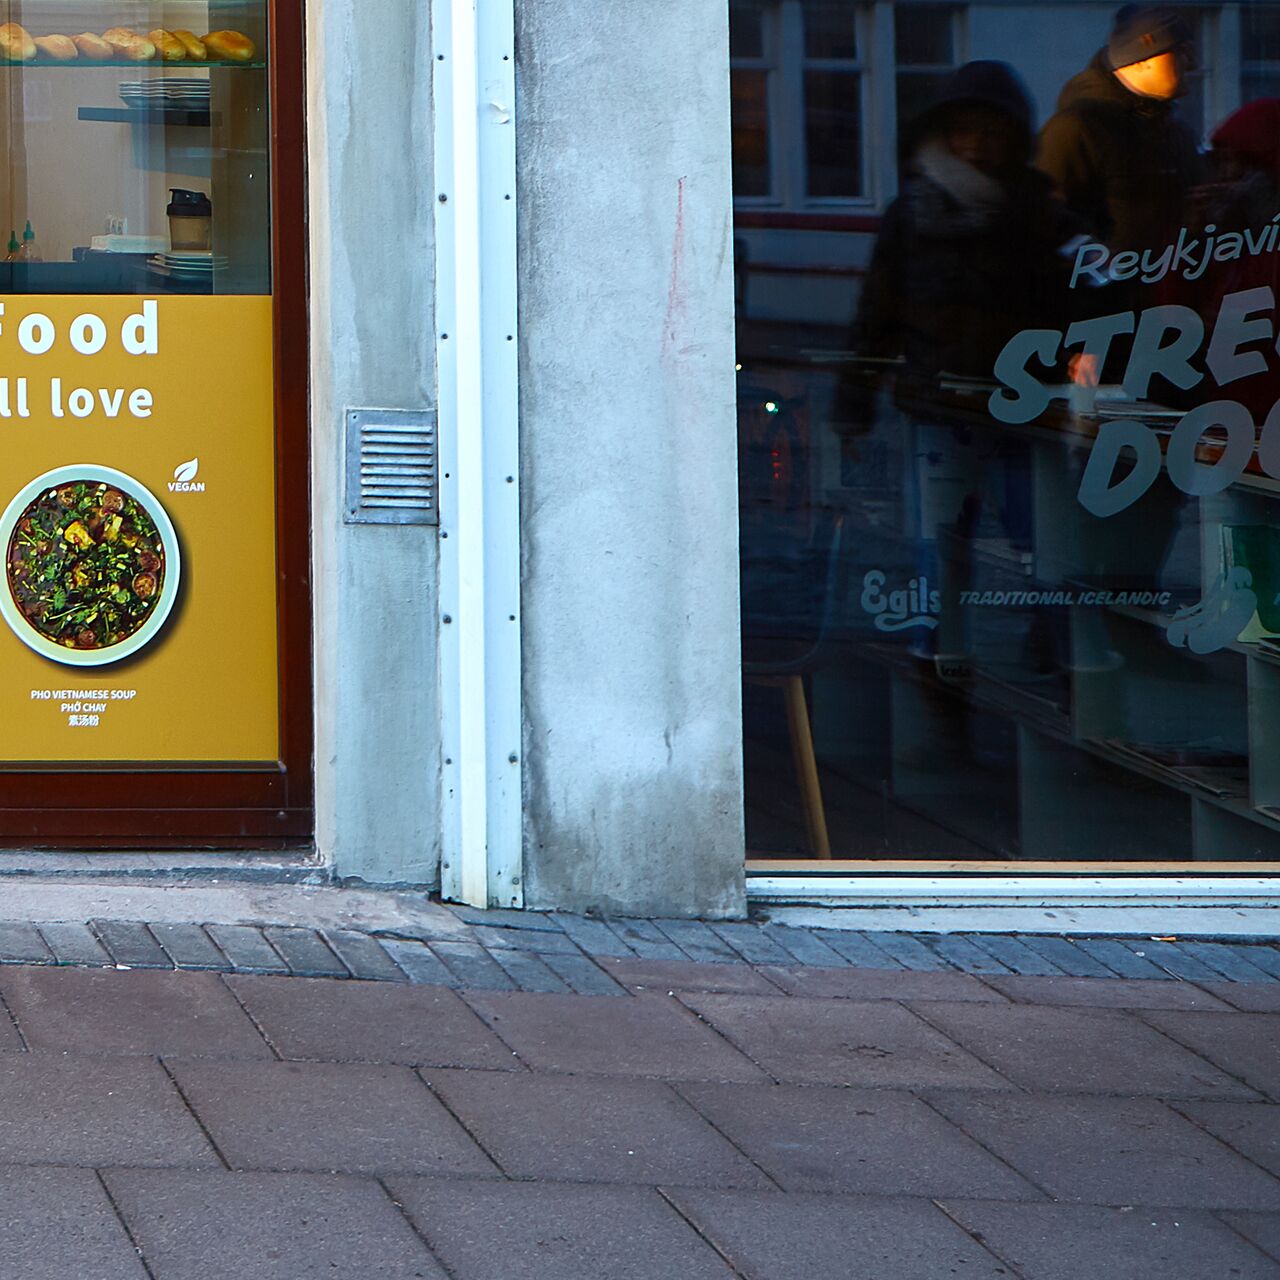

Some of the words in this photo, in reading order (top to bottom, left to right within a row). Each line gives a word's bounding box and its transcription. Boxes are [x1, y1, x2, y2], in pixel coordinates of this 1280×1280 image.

[1068, 214, 1280, 289] Reykjaví
[988, 286, 1280, 424] STRE
[51, 377, 154, 418] love
[1076, 399, 1280, 519] DO
[167, 482, 206, 492] VEGAN
[860, 568, 942, 632] Egils
[959, 591, 1073, 606] TRADITIONAL
[1077, 591, 1172, 606] ICELANDIC
[31, 690, 51, 699] PHO
[52, 690, 109, 699] VIETNAMESE
[110, 690, 137, 699] SOUP
[82, 703, 107, 712] CHAY
